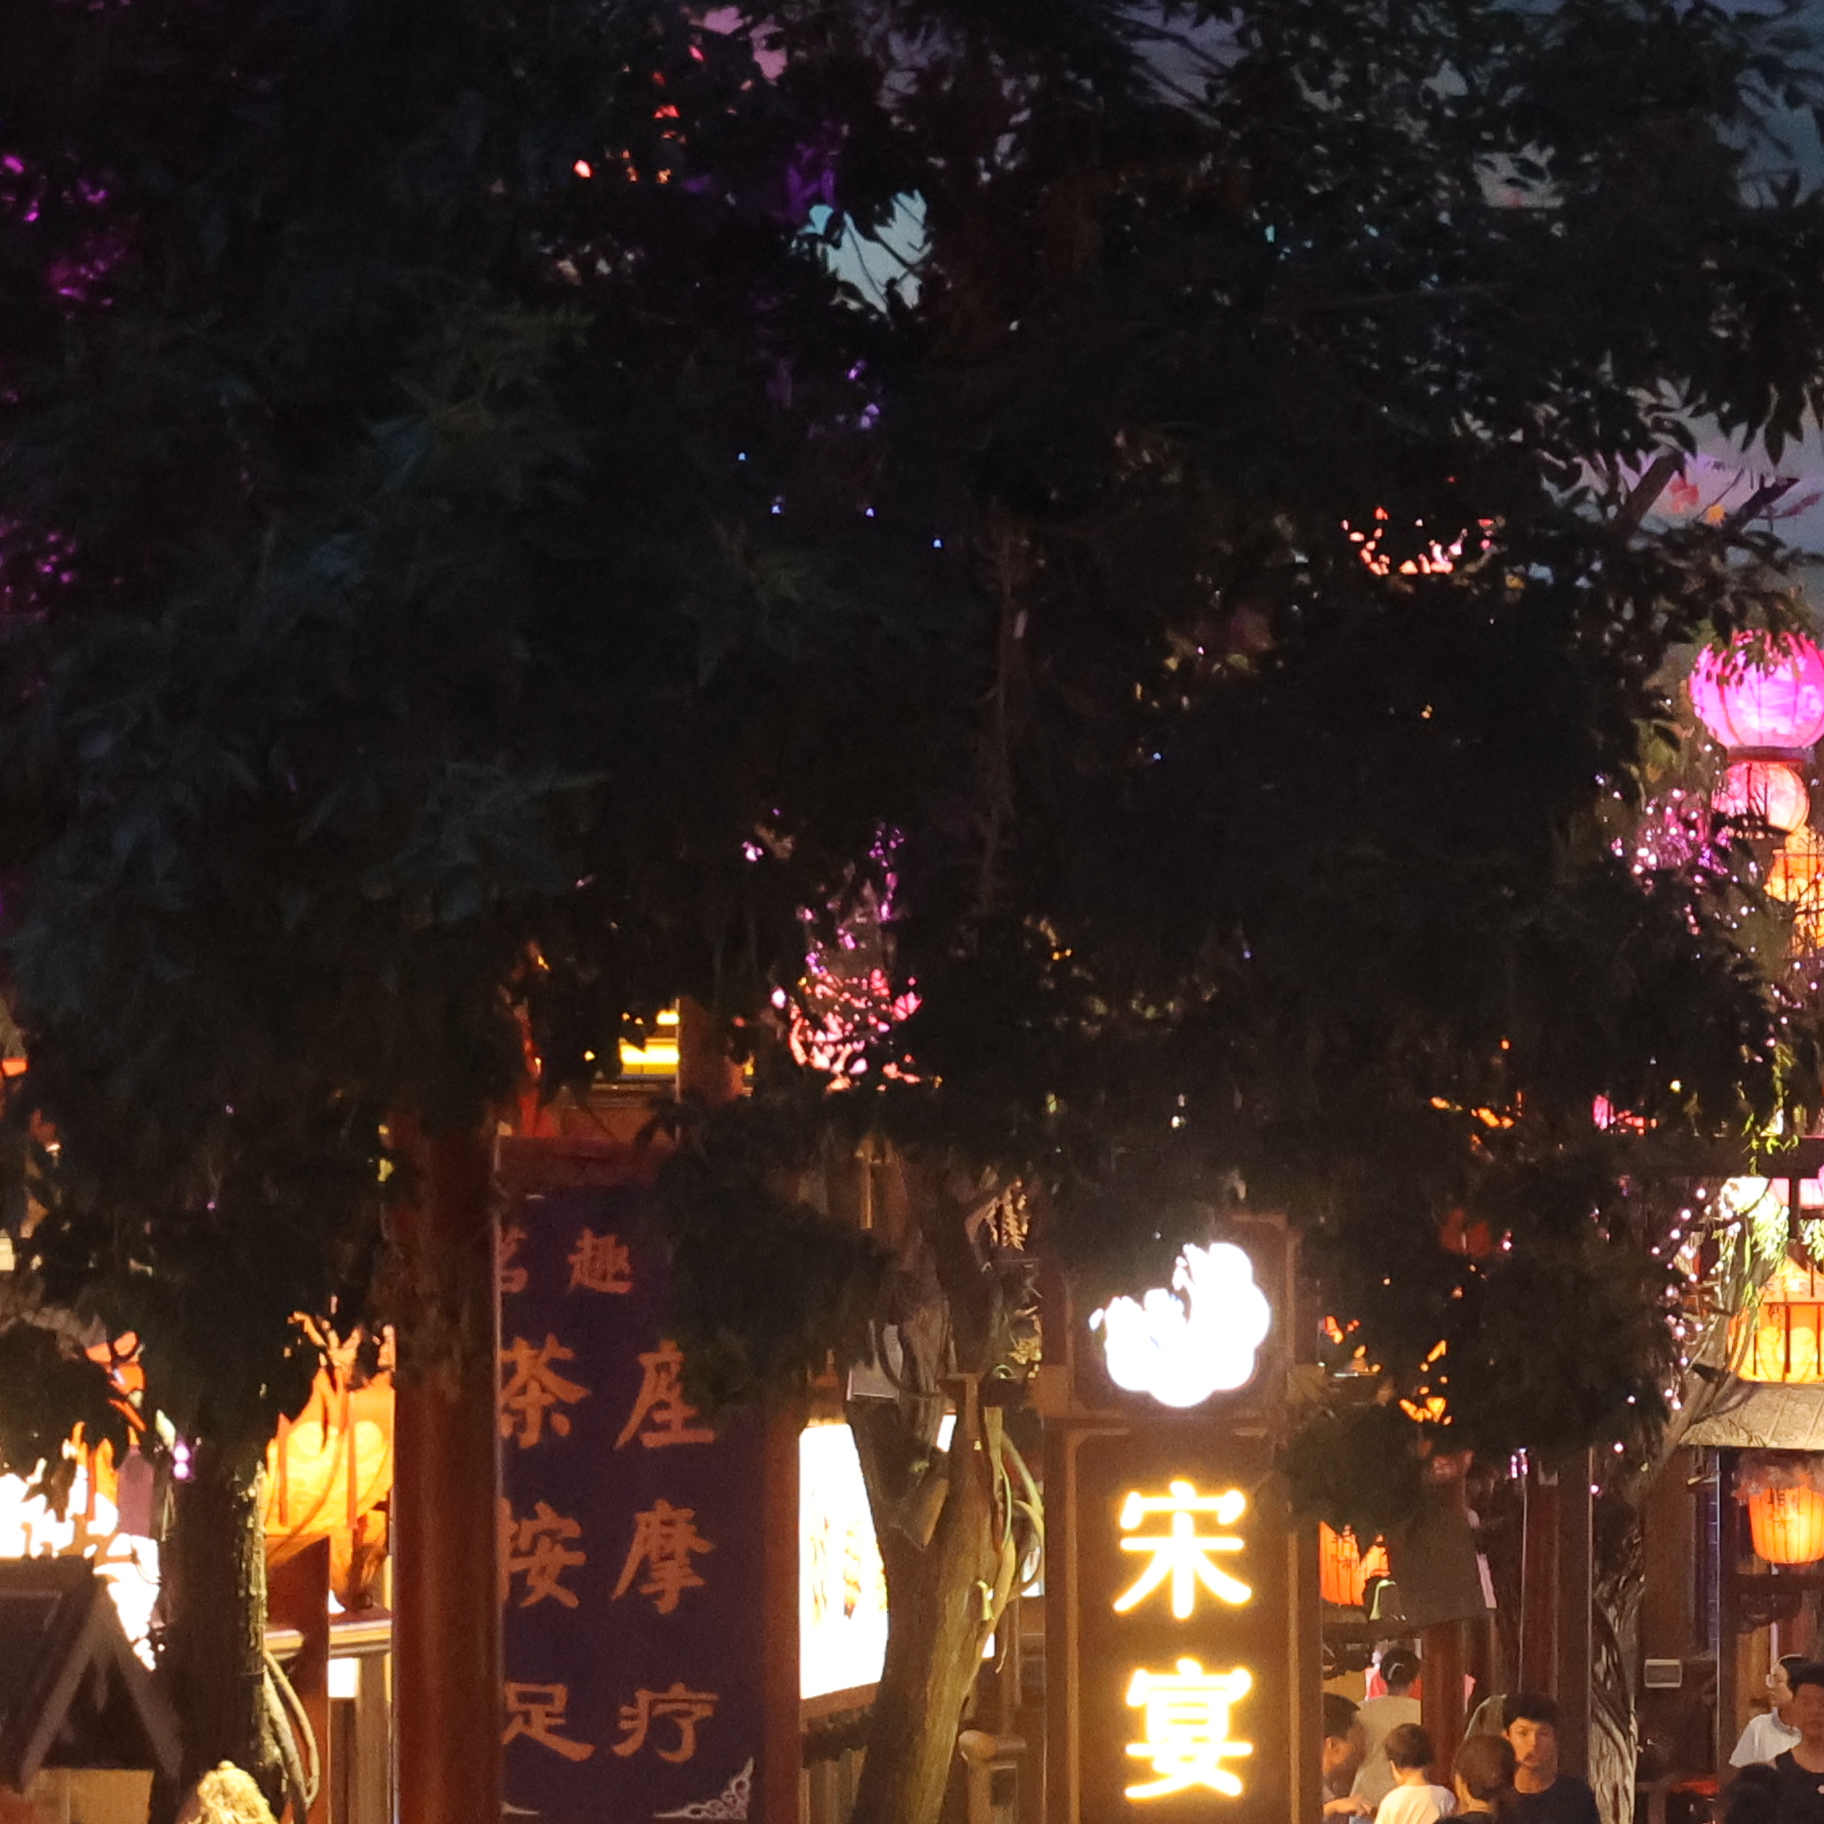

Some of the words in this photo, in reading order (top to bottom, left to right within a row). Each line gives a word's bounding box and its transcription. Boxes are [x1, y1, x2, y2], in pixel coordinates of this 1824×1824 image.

[500, 1498, 716, 1614] 按摩
[1113, 1480, 1253, 1800] 宋宴
[500, 1682, 719, 1763] 足疗
